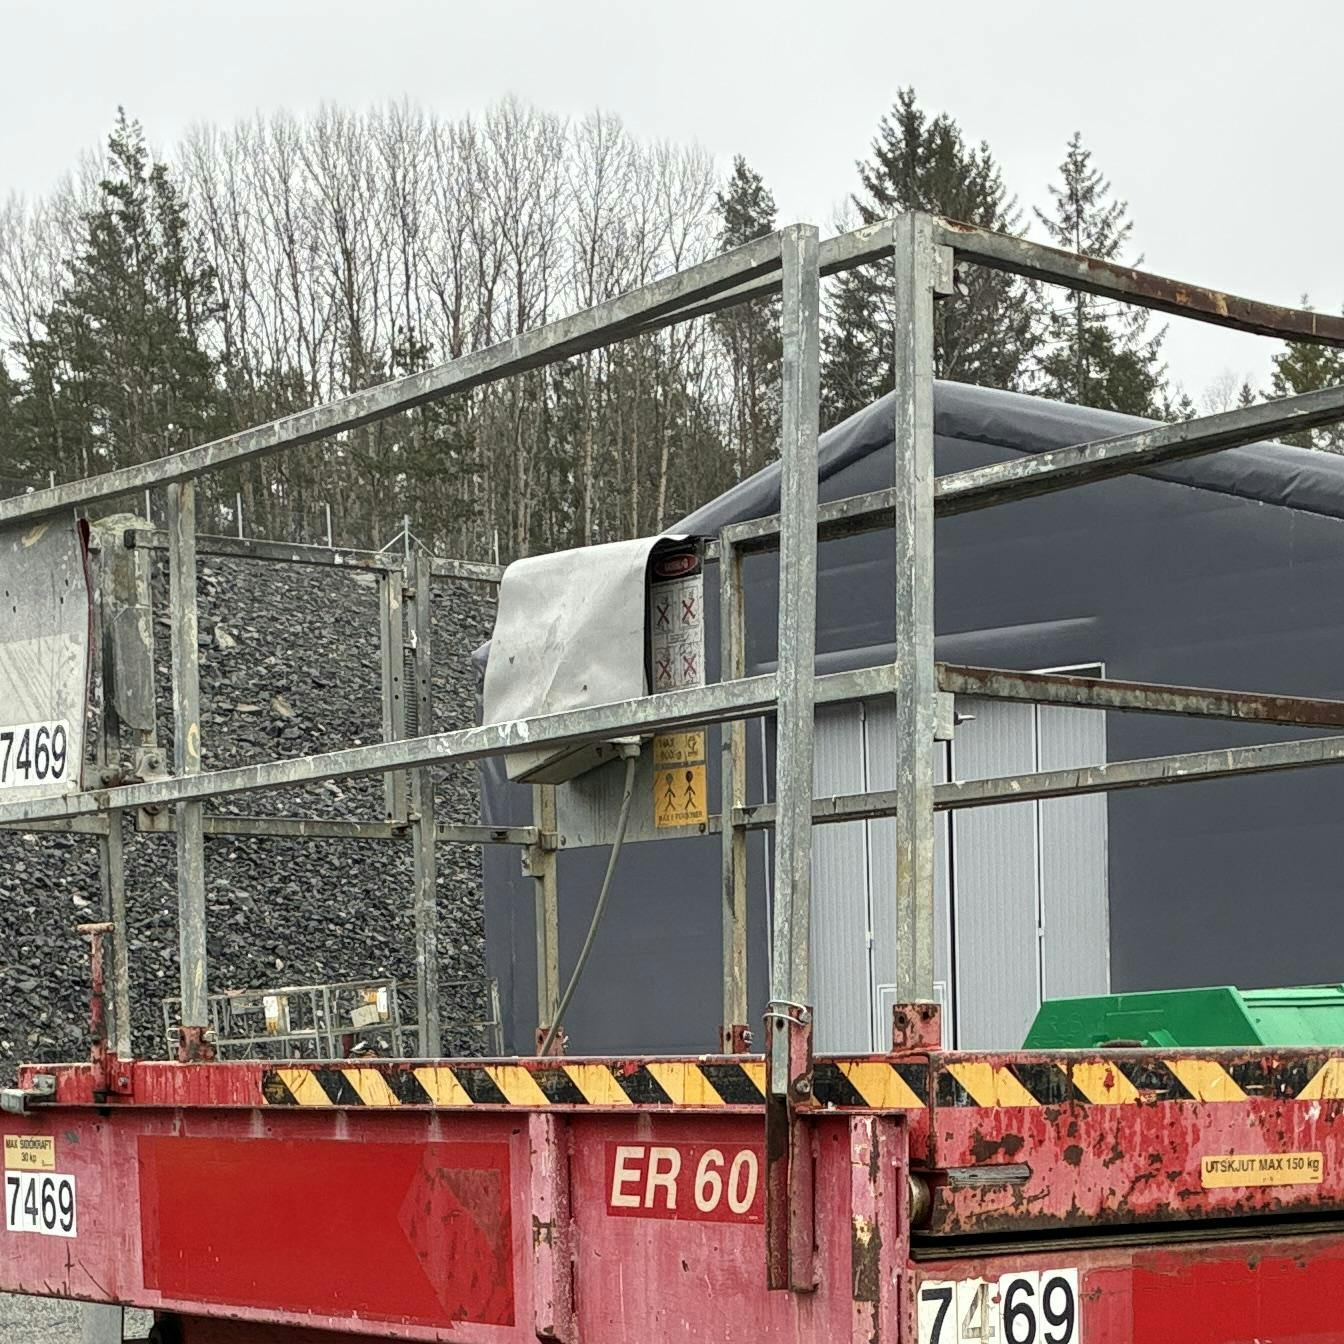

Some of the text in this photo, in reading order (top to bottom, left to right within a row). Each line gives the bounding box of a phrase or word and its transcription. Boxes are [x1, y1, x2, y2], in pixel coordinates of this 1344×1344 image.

[0, 724, 67, 783] 7469
[611, 1146, 759, 1214] ER 60
[1205, 1156, 1320, 1173] UTSKJUT MAX 150 kg
[7, 1176, 74, 1232] 7469
